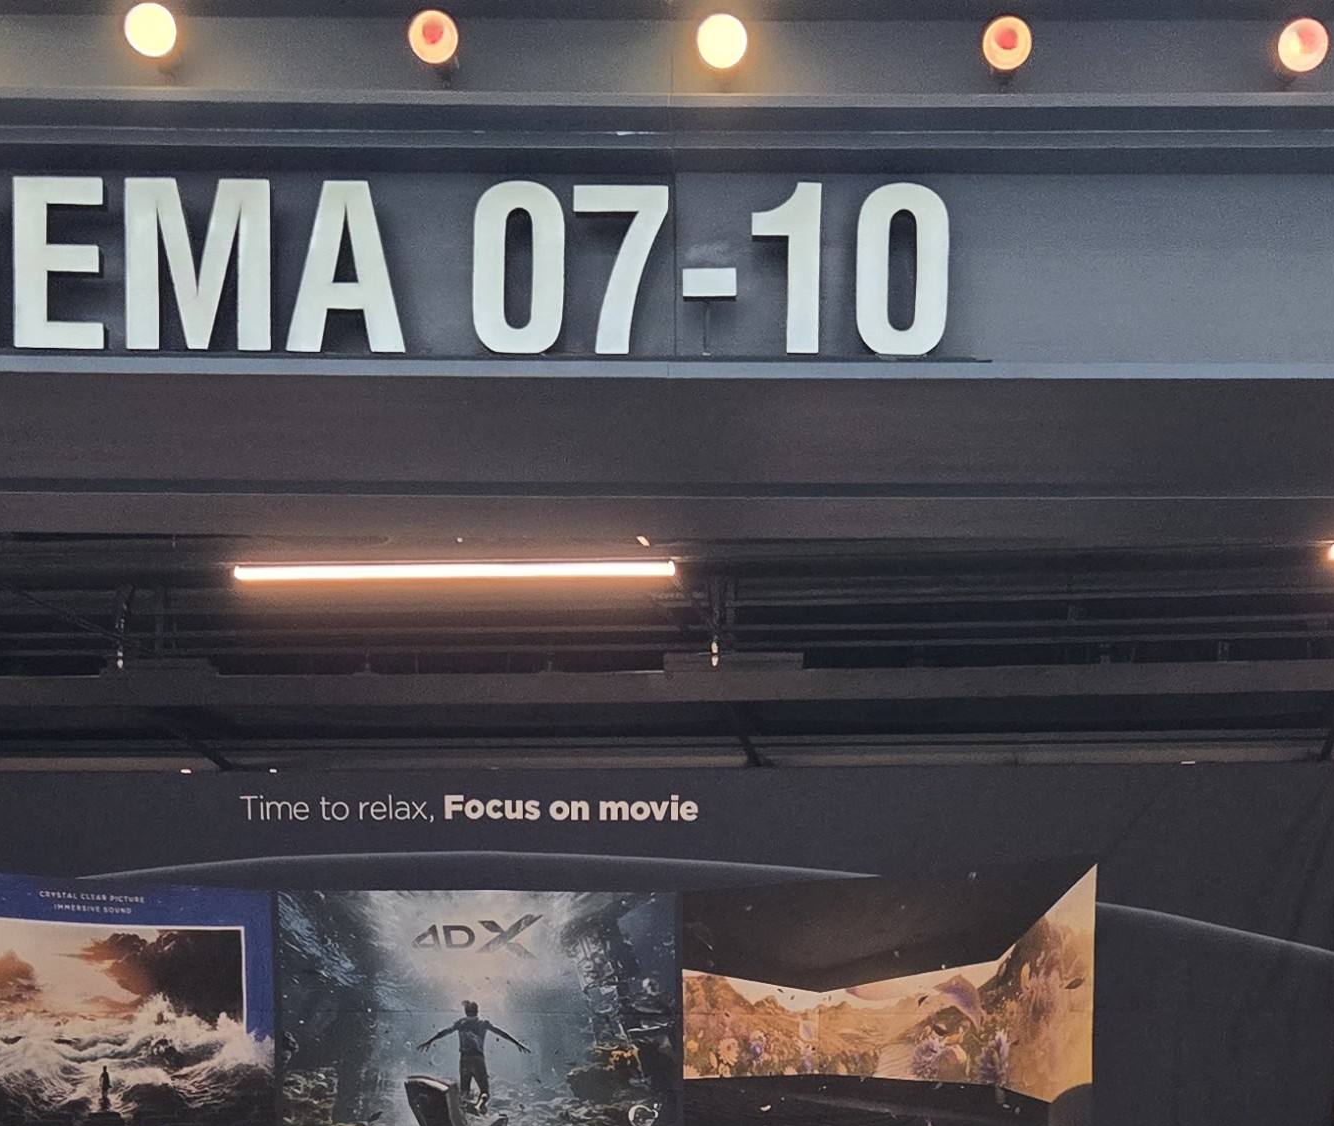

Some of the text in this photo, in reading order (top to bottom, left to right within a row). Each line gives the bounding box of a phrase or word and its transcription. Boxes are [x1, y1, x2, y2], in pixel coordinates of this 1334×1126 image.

[470, 180, 951, 355] 07-10
[239, 793, 699, 823] Time to relax, Focus on movie
[38, 890, 145, 903] CRYSTAL CLEAR PICTURE
[53, 903, 132, 914] IMMERSIVE SOUND
